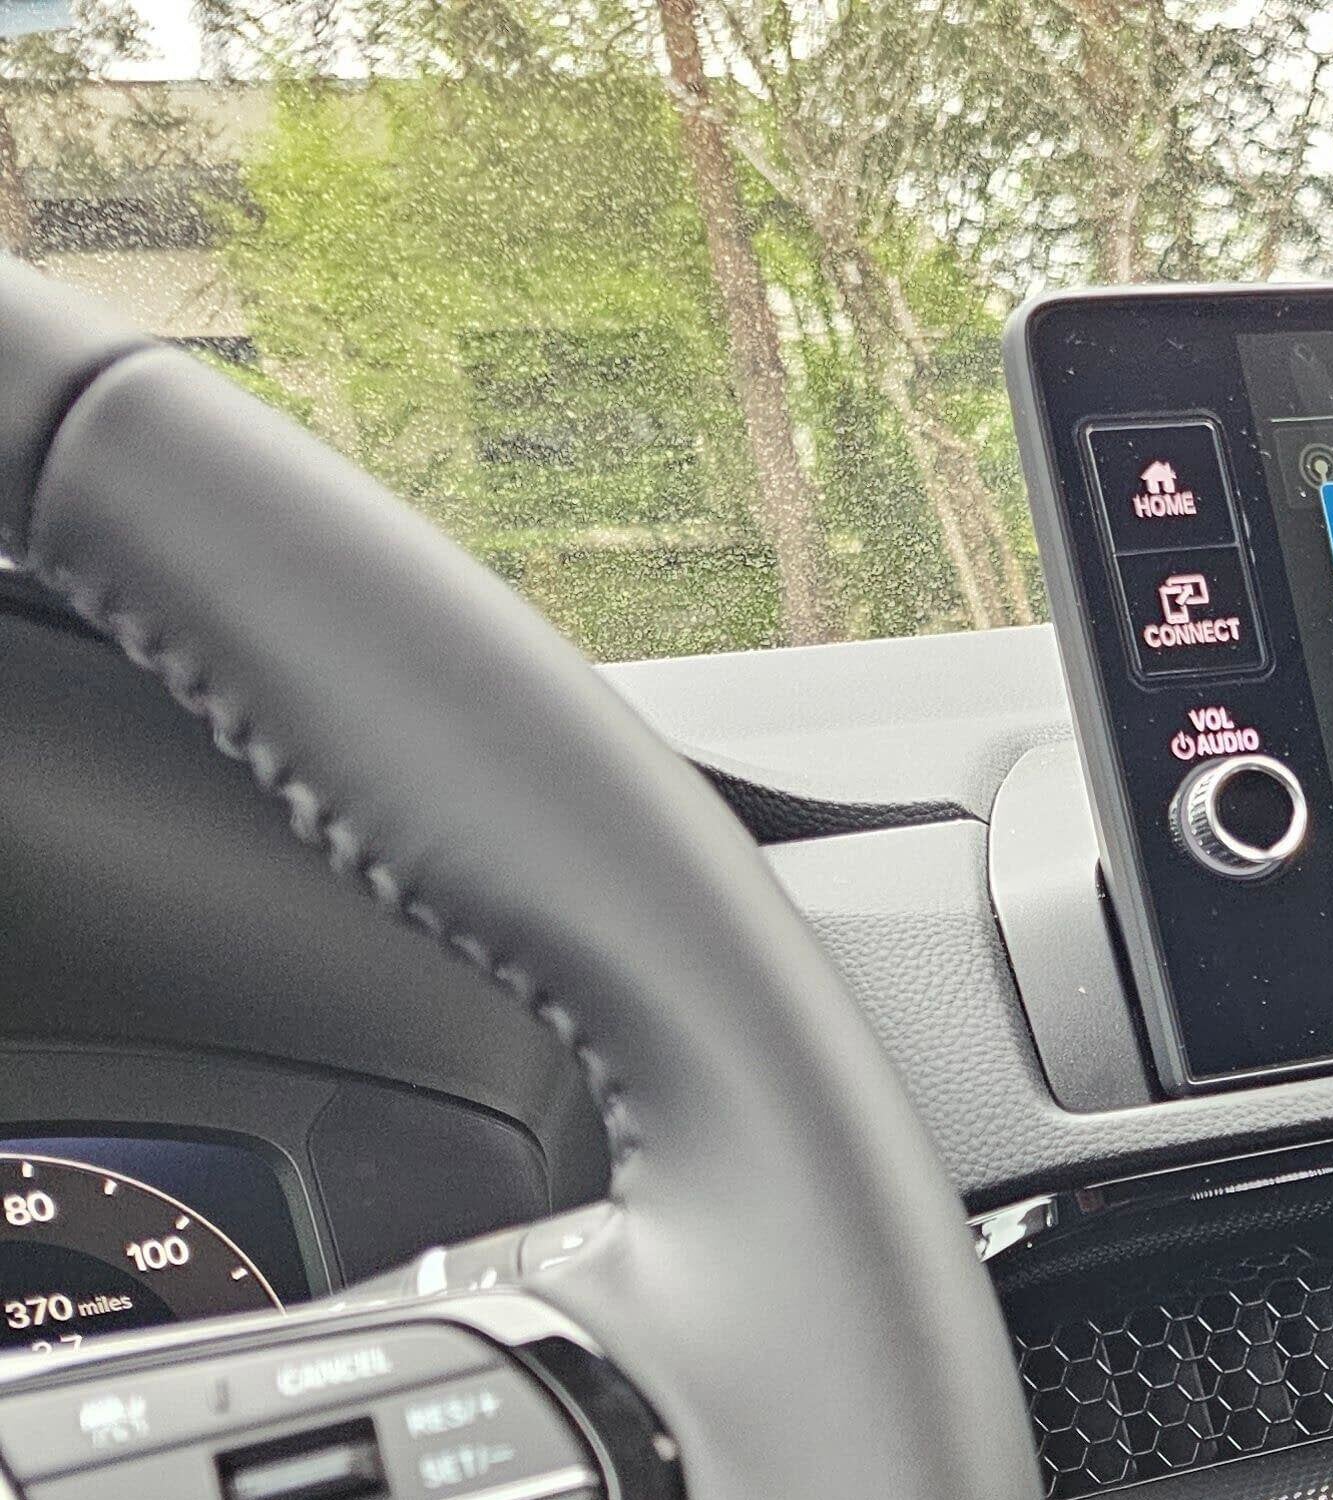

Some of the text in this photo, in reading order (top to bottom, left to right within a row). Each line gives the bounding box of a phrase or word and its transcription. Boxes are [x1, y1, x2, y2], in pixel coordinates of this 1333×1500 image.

[1133, 491, 1197, 518] HOME
[1144, 617, 1240, 648] CONNECT
[1188, 706, 1234, 732] VOL
[1197, 728, 1259, 756] AUDIO
[3, 1190, 56, 1226] 80
[126, 1235, 190, 1272] 100
[5, 1293, 134, 1329] 370 miles
